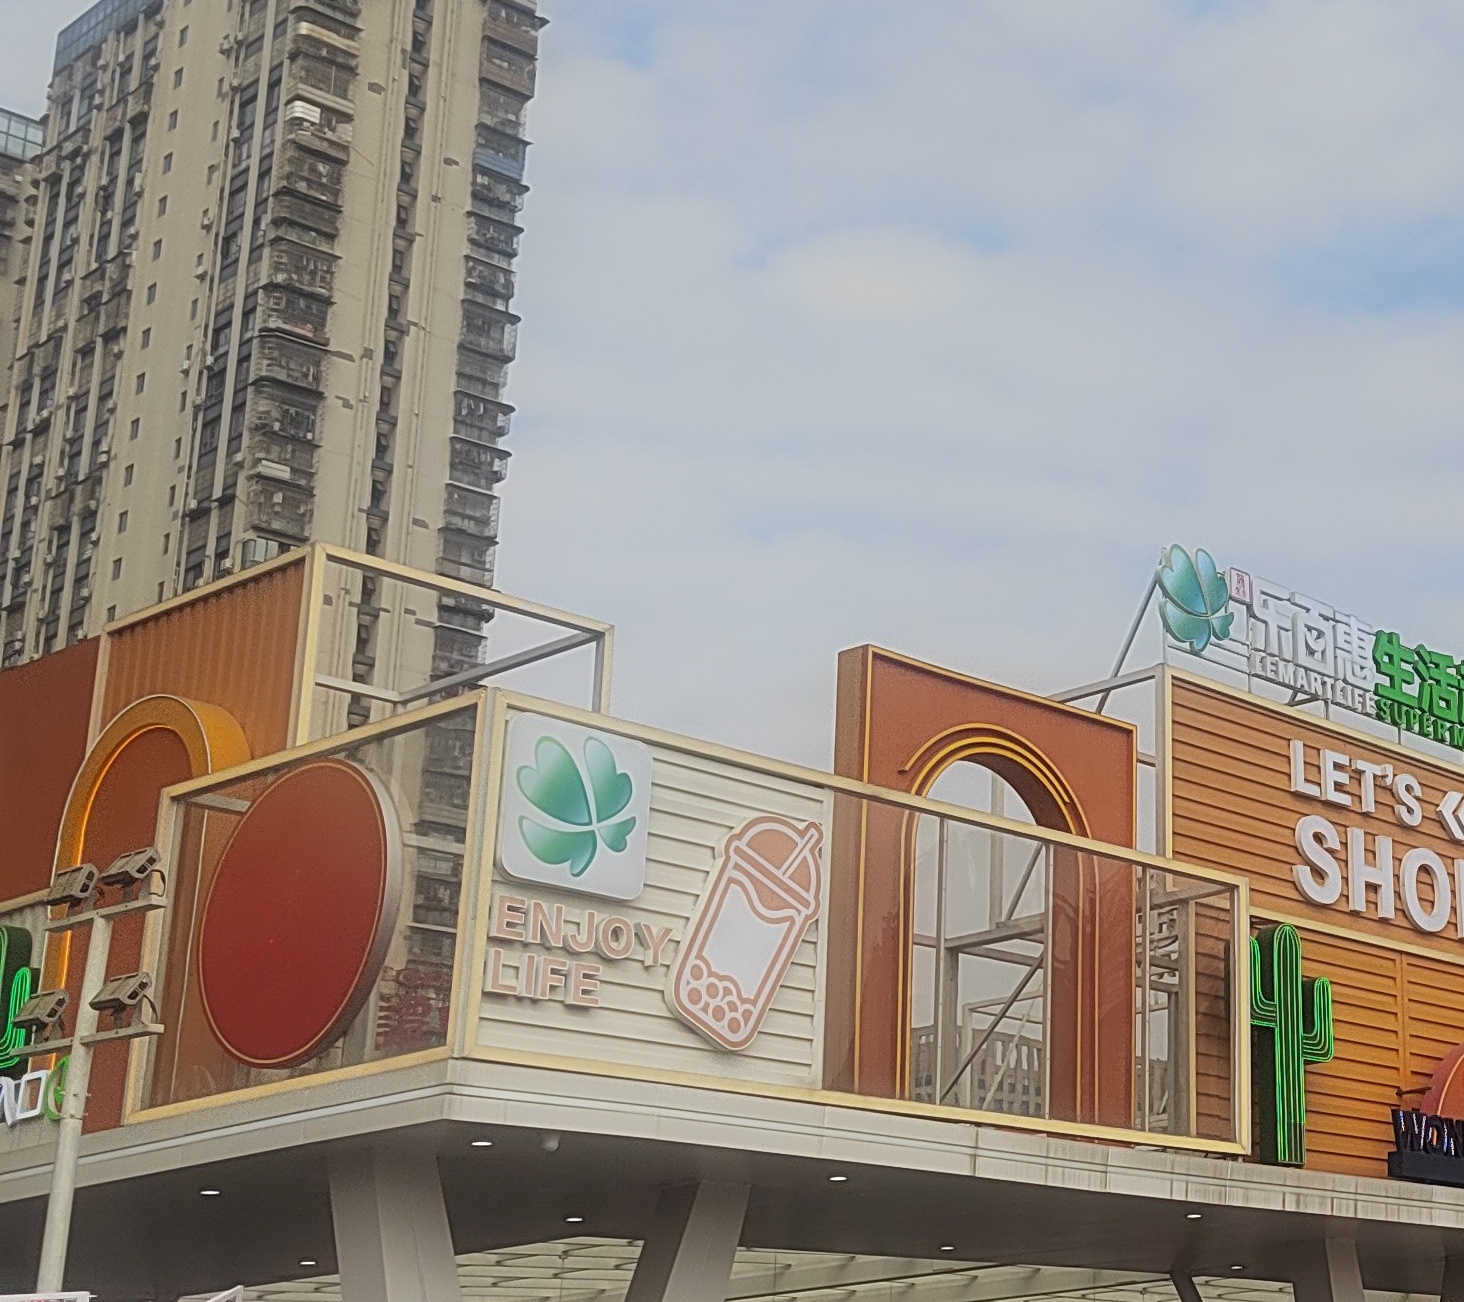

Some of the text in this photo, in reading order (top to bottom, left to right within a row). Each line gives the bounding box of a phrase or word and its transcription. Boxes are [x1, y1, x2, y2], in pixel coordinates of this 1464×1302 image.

[1289, 739, 1423, 827] LET'S
[489, 893, 673, 967] ENJOY
[483, 947, 601, 1008] LIFE
